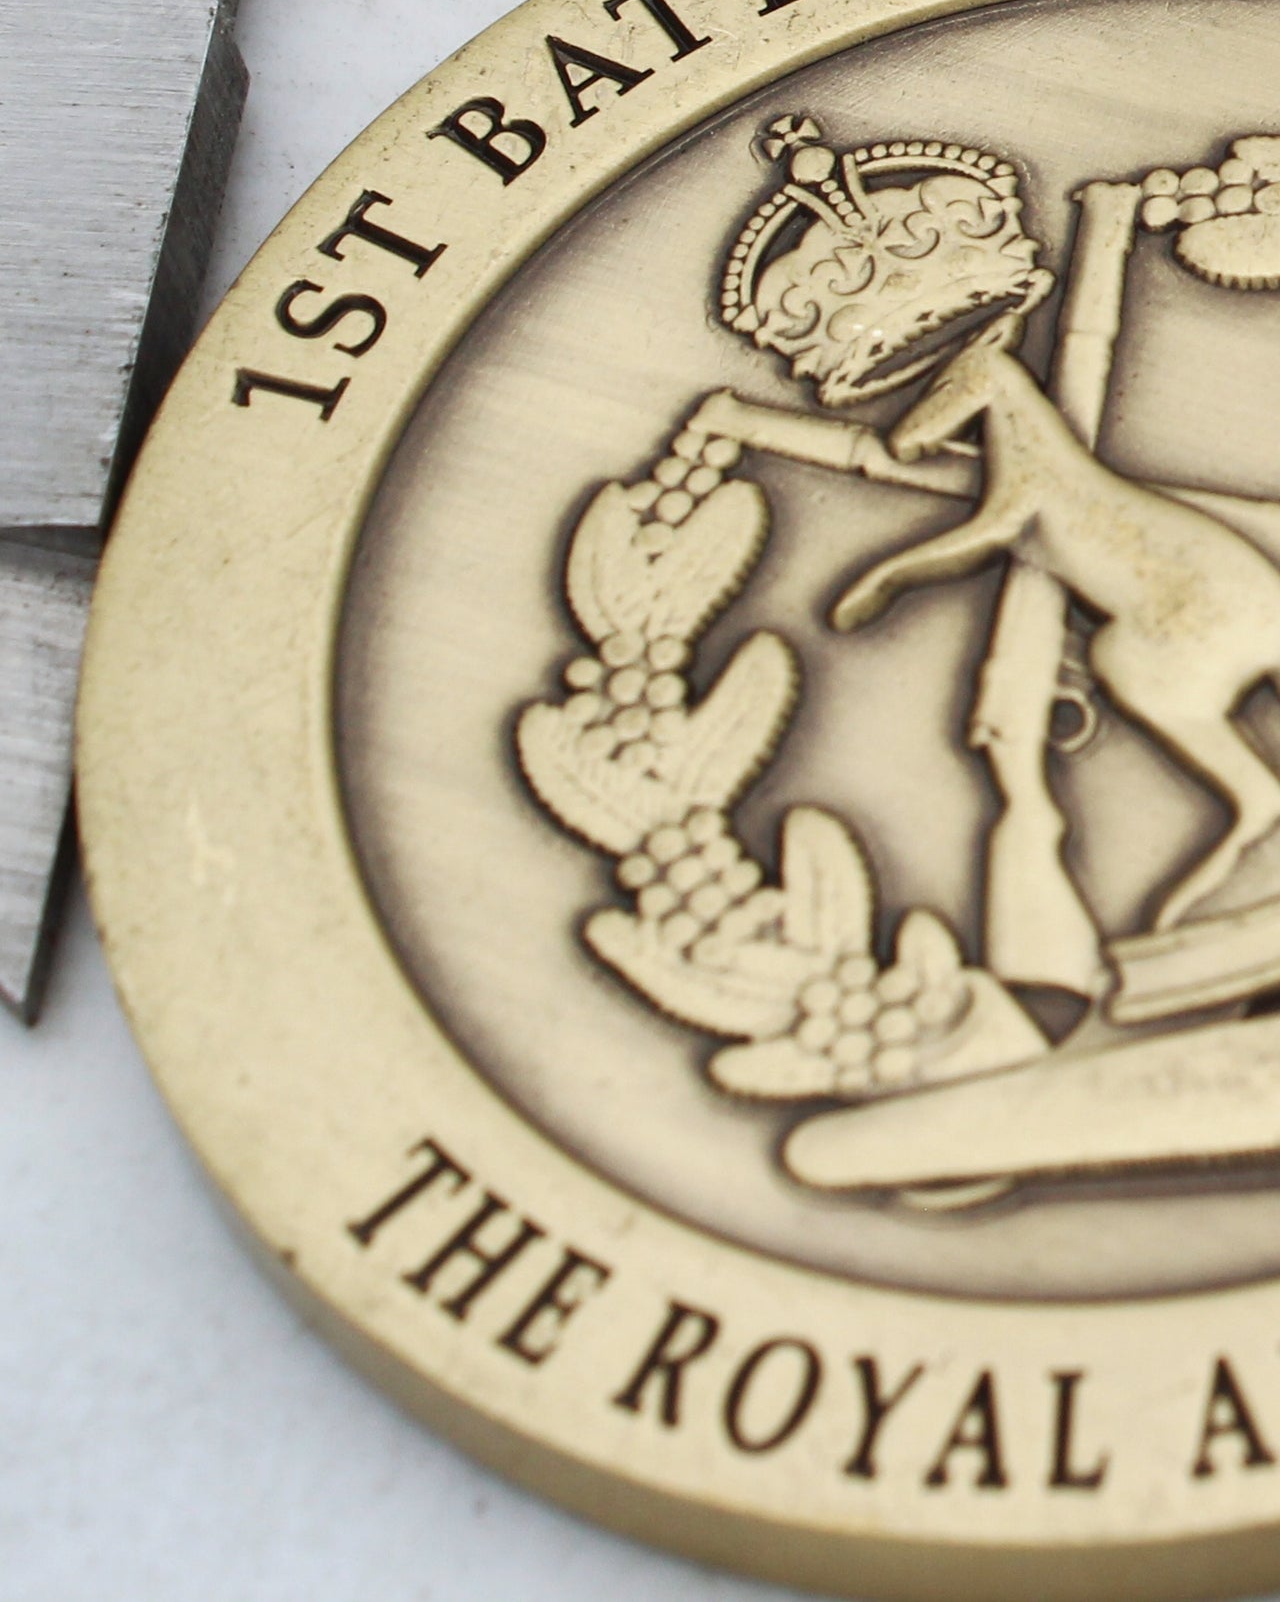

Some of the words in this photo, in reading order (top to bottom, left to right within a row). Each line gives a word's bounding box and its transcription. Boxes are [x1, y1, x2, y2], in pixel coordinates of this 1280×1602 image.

[232, 188, 450, 424] 1ST
[345, 1136, 613, 1368] THE
[612, 1299, 1112, 1491] ROYAL
